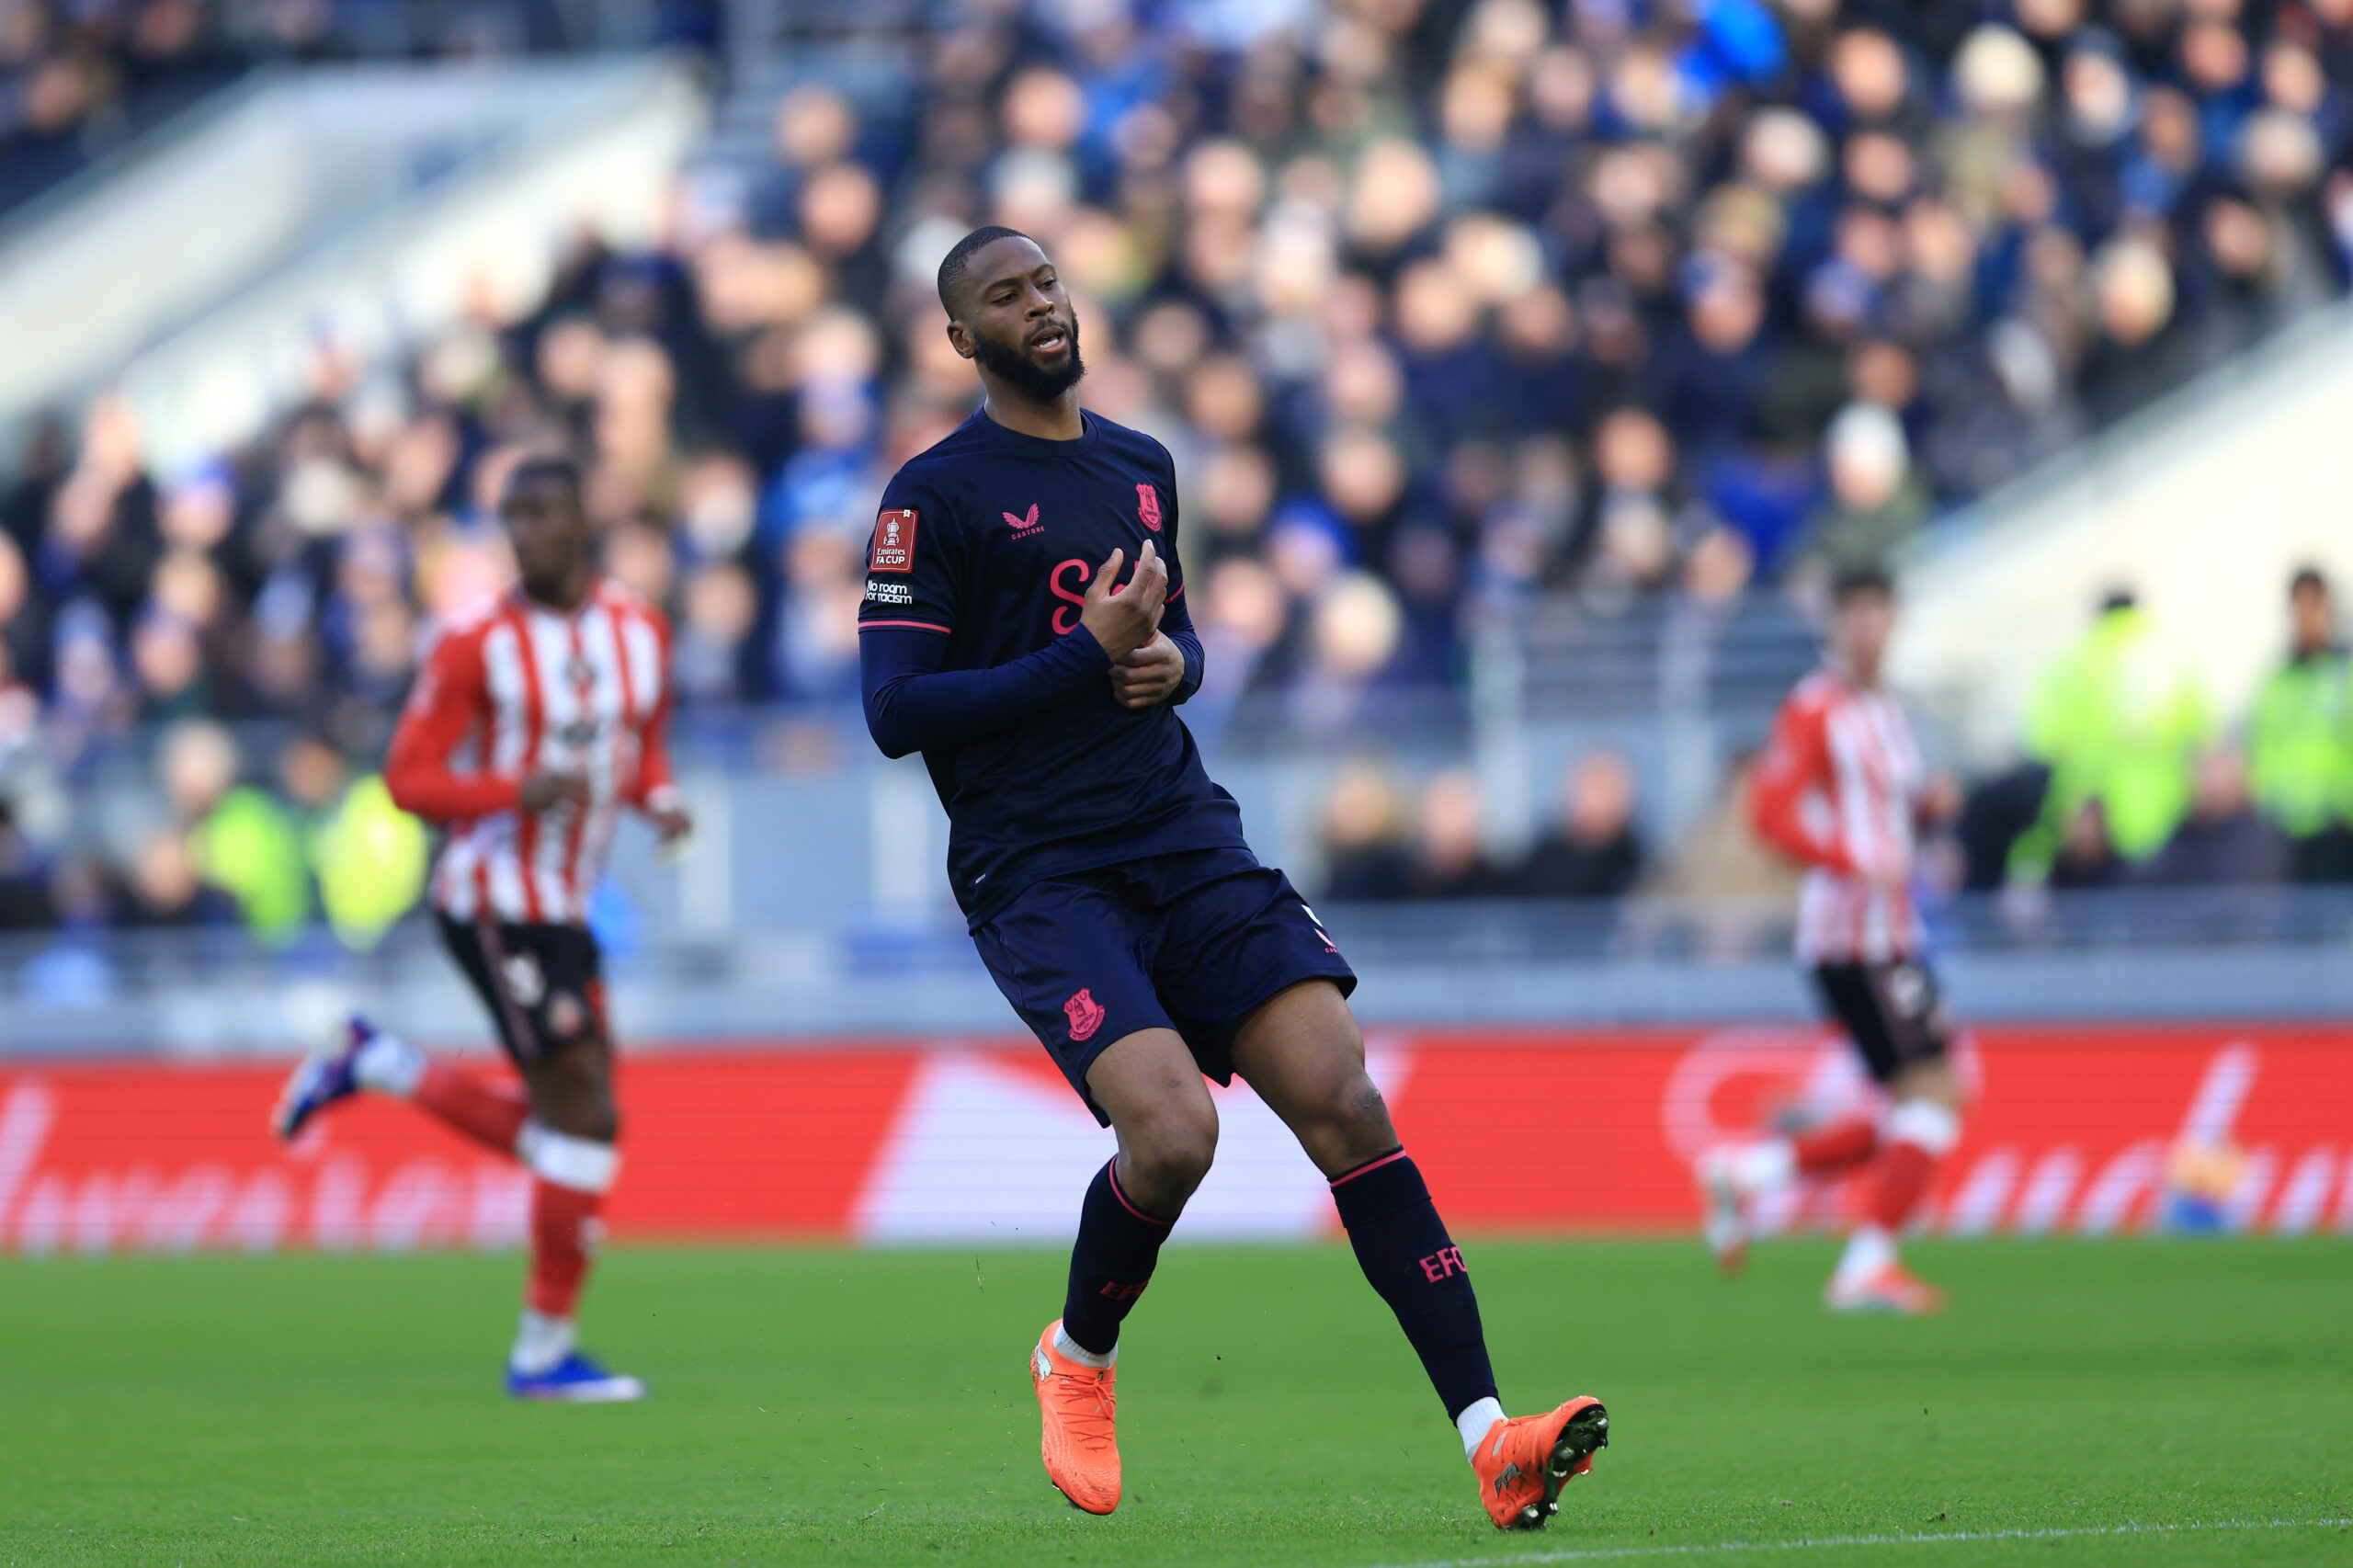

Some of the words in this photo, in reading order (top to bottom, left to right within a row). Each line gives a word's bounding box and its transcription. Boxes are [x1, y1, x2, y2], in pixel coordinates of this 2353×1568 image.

[876, 555, 885, 564] FA
[885, 555, 905, 564] CUP
[867, 580, 877, 591] No
[879, 583, 907, 594] room
[878, 594, 912, 604] racism
